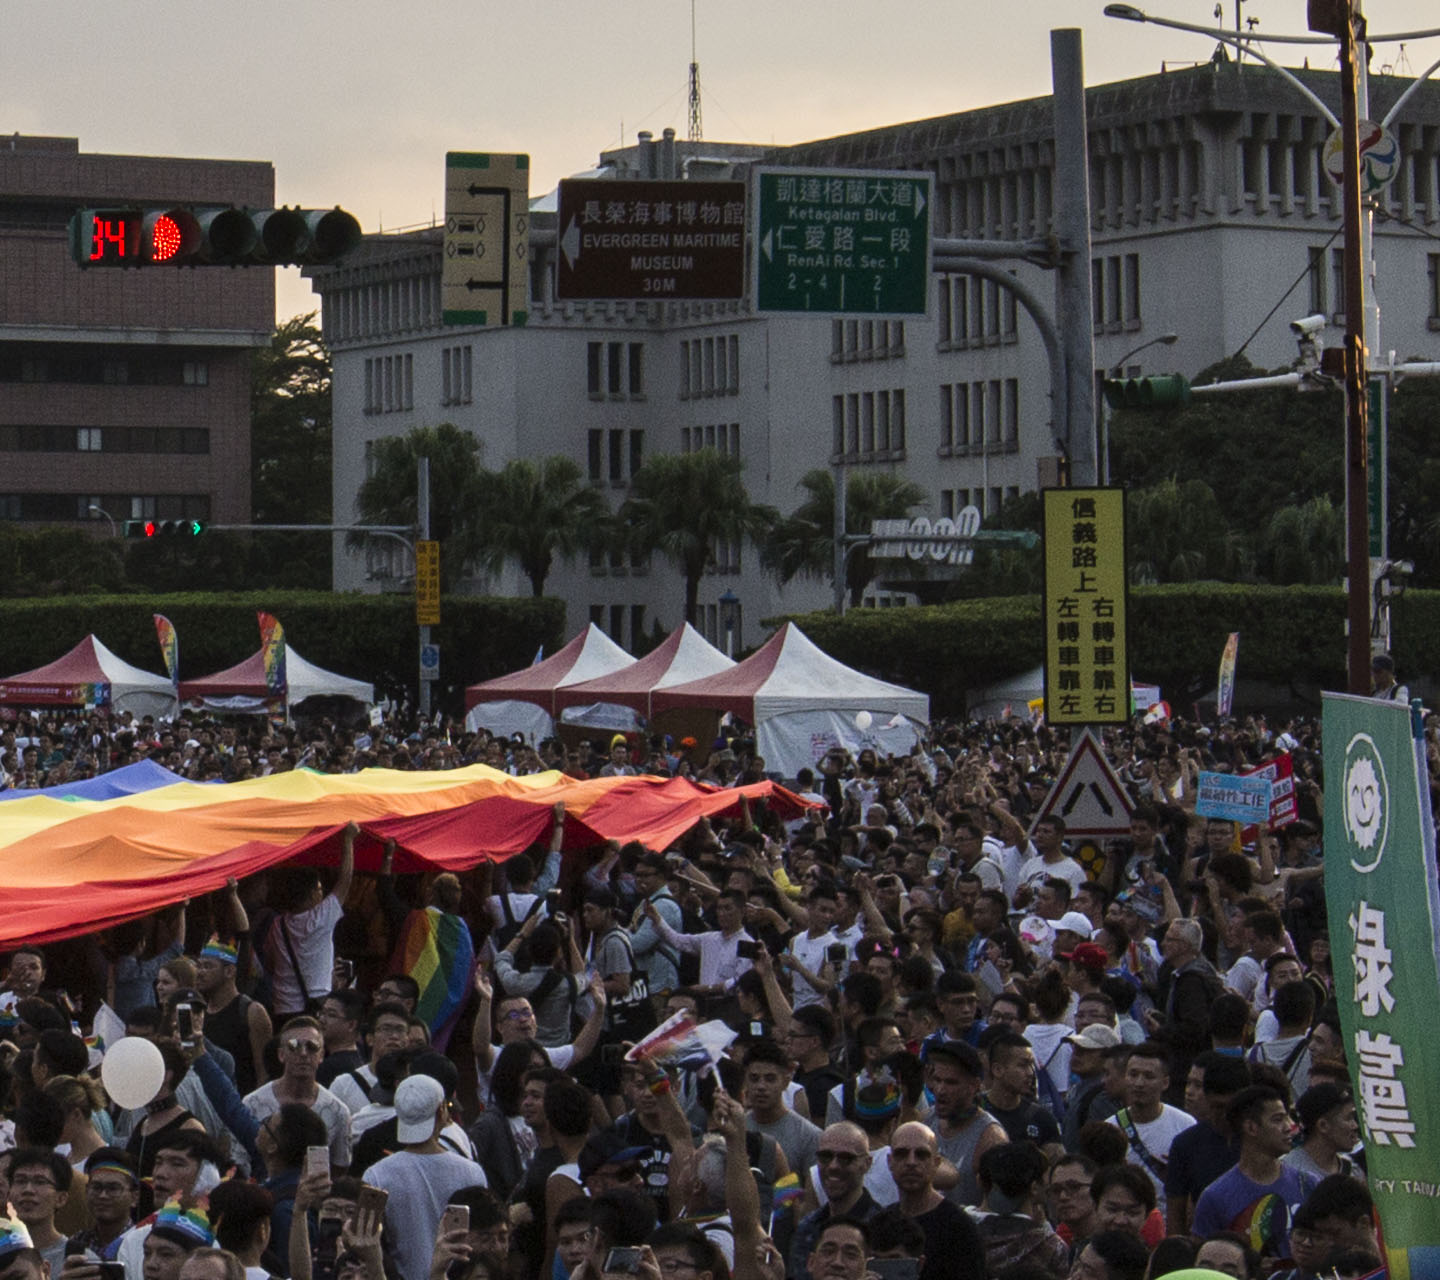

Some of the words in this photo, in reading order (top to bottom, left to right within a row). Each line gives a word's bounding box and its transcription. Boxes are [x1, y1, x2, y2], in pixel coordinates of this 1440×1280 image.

[777, 177, 912, 207] 凱達格蘭大道
[582, 200, 745, 226] 長榮海事博物館
[788, 206, 860, 223] Ketagalan
[864, 207, 899, 222] Blvd.
[583, 233, 669, 249] EVERGREEN
[673, 233, 740, 248] MARITIME
[776, 225, 912, 254] 仁愛路一段
[630, 255, 694, 271] MUSEUM
[787, 254, 831, 268] RenAi
[833, 255, 856, 268] Rd.
[642, 277, 676, 293] 30M
[1072, 497, 1098, 593] 信義路上
[1057, 596, 1081, 716] 左轉車靠左
[1092, 596, 1116, 716] 右轉車靠右
